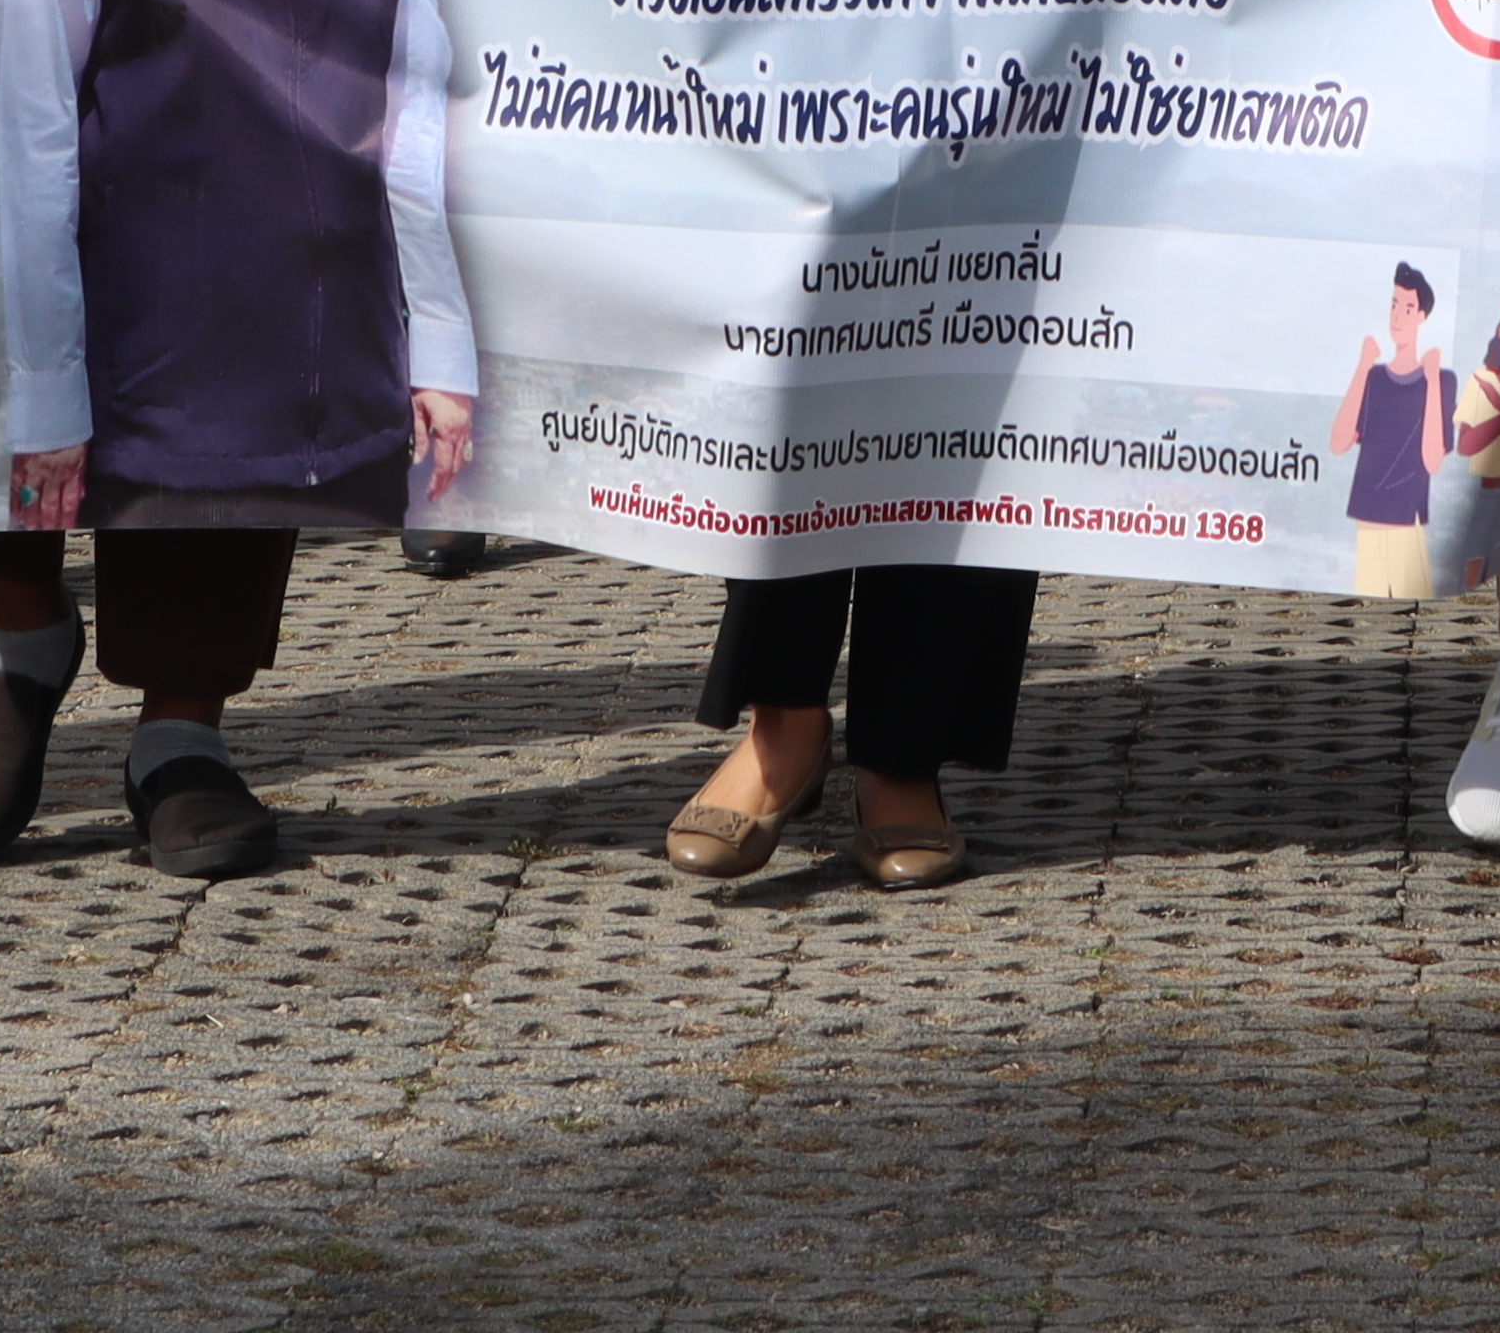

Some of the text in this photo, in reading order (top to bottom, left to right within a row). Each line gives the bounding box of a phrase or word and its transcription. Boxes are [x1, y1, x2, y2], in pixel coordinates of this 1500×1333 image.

[484, 44, 767, 145] ไม่มีคนหน้าใหม่
[778, 50, 1079, 163] เพราะคนรุ่นใหม่
[802, 239, 941, 293] นางนันทนี
[723, 299, 1135, 358] นายกเทศมนตรี เมืองดอนสัก
[589, 484, 1264, 544] พบเห็นหรือต้องการแจ้งเบาะแสยาเสพติด โทรสายด่วน 1368
